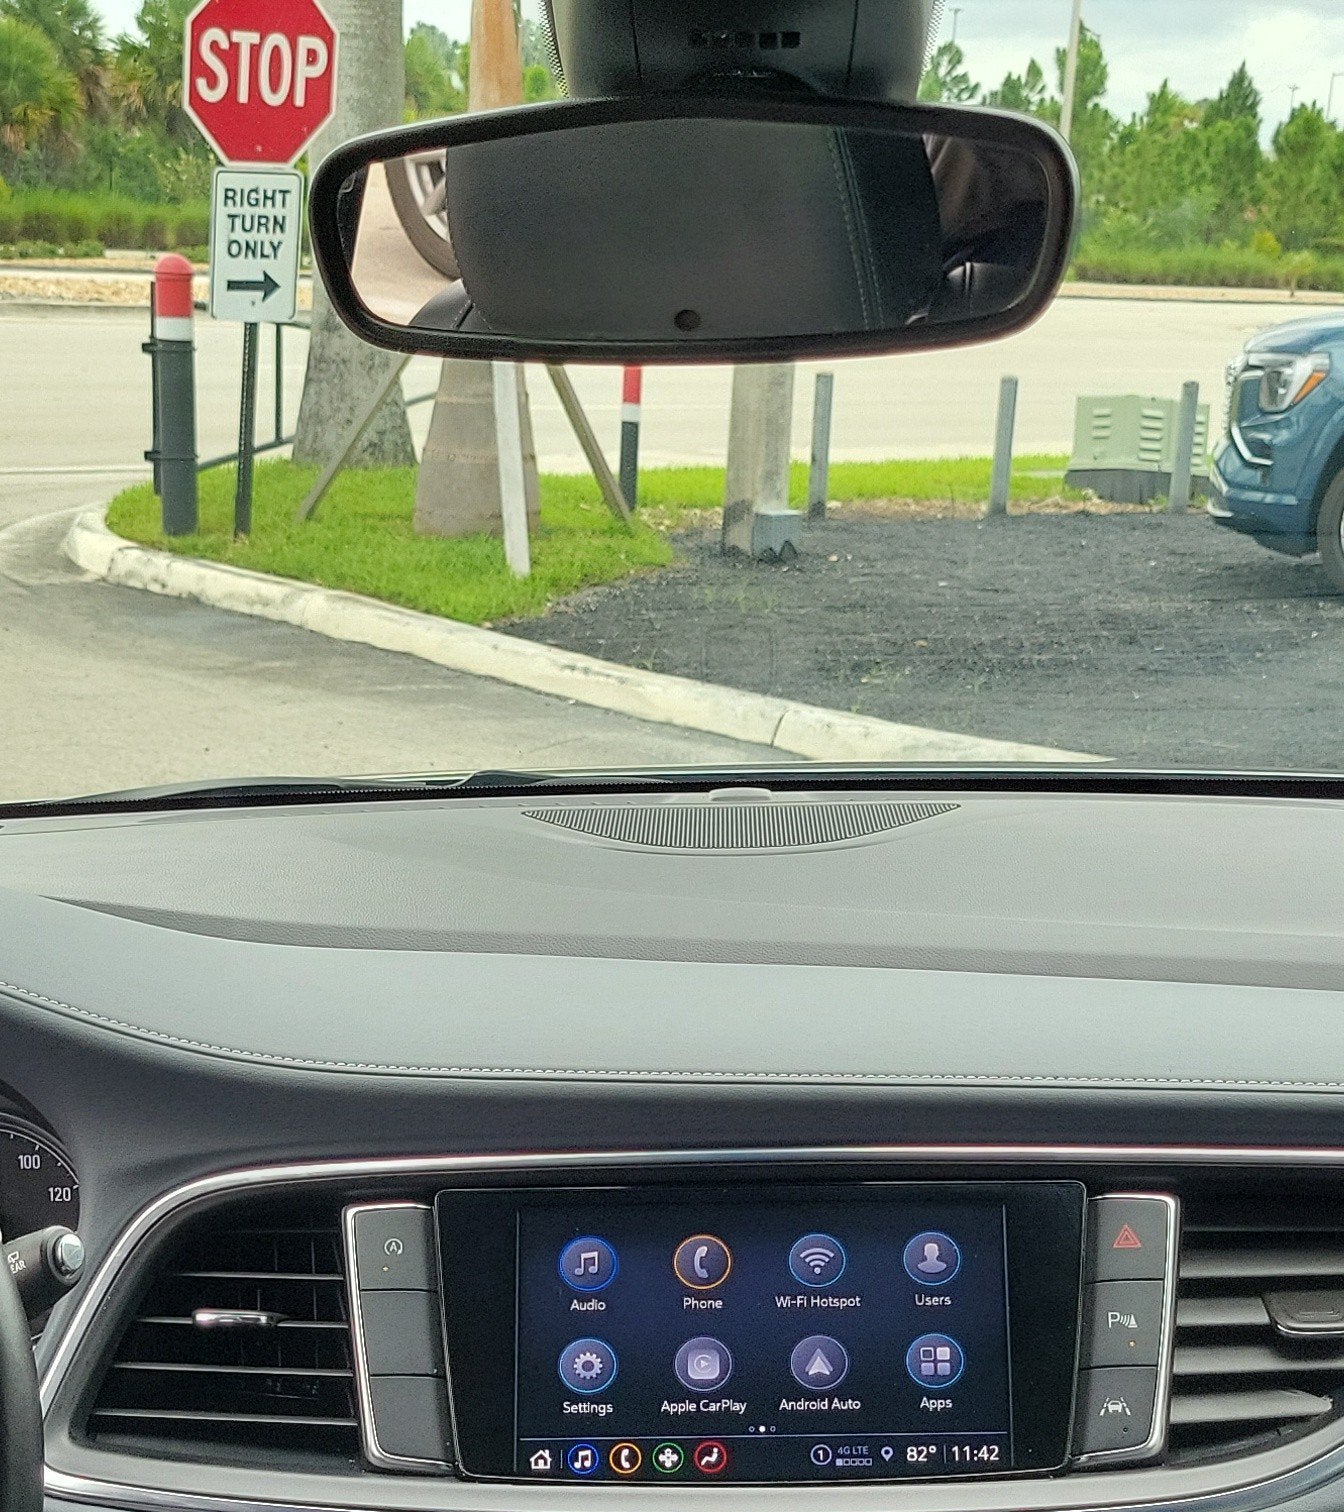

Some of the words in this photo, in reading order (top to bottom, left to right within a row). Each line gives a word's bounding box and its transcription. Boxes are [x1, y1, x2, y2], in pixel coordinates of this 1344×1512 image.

[195, 27, 328, 108] STOP
[223, 187, 291, 209] RIGHT
[227, 213, 286, 235] TURN
[227, 239, 283, 261] ONLY
[18, 1154, 41, 1170] 100
[48, 1187, 71, 1202] 120
[570, 1297, 606, 1312] Audio
[683, 1297, 723, 1310] Phone
[775, 1295, 808, 1308] Wi-Fi
[810, 1294, 861, 1309] Hotspot
[915, 1294, 951, 1307] Users
[562, 1401, 613, 1416] Settings
[661, 1400, 697, 1415] Apple
[699, 1399, 747, 1414] CarPlay
[779, 1397, 829, 1411] Android
[831, 1397, 861, 1411] Auto
[920, 1396, 953, 1410] Apps
[837, 1446, 850, 1456] 4G
[851, 1446, 870, 1455] LTE
[906, 1445, 937, 1462] 82°
[951, 1445, 1000, 1462] 11:42
